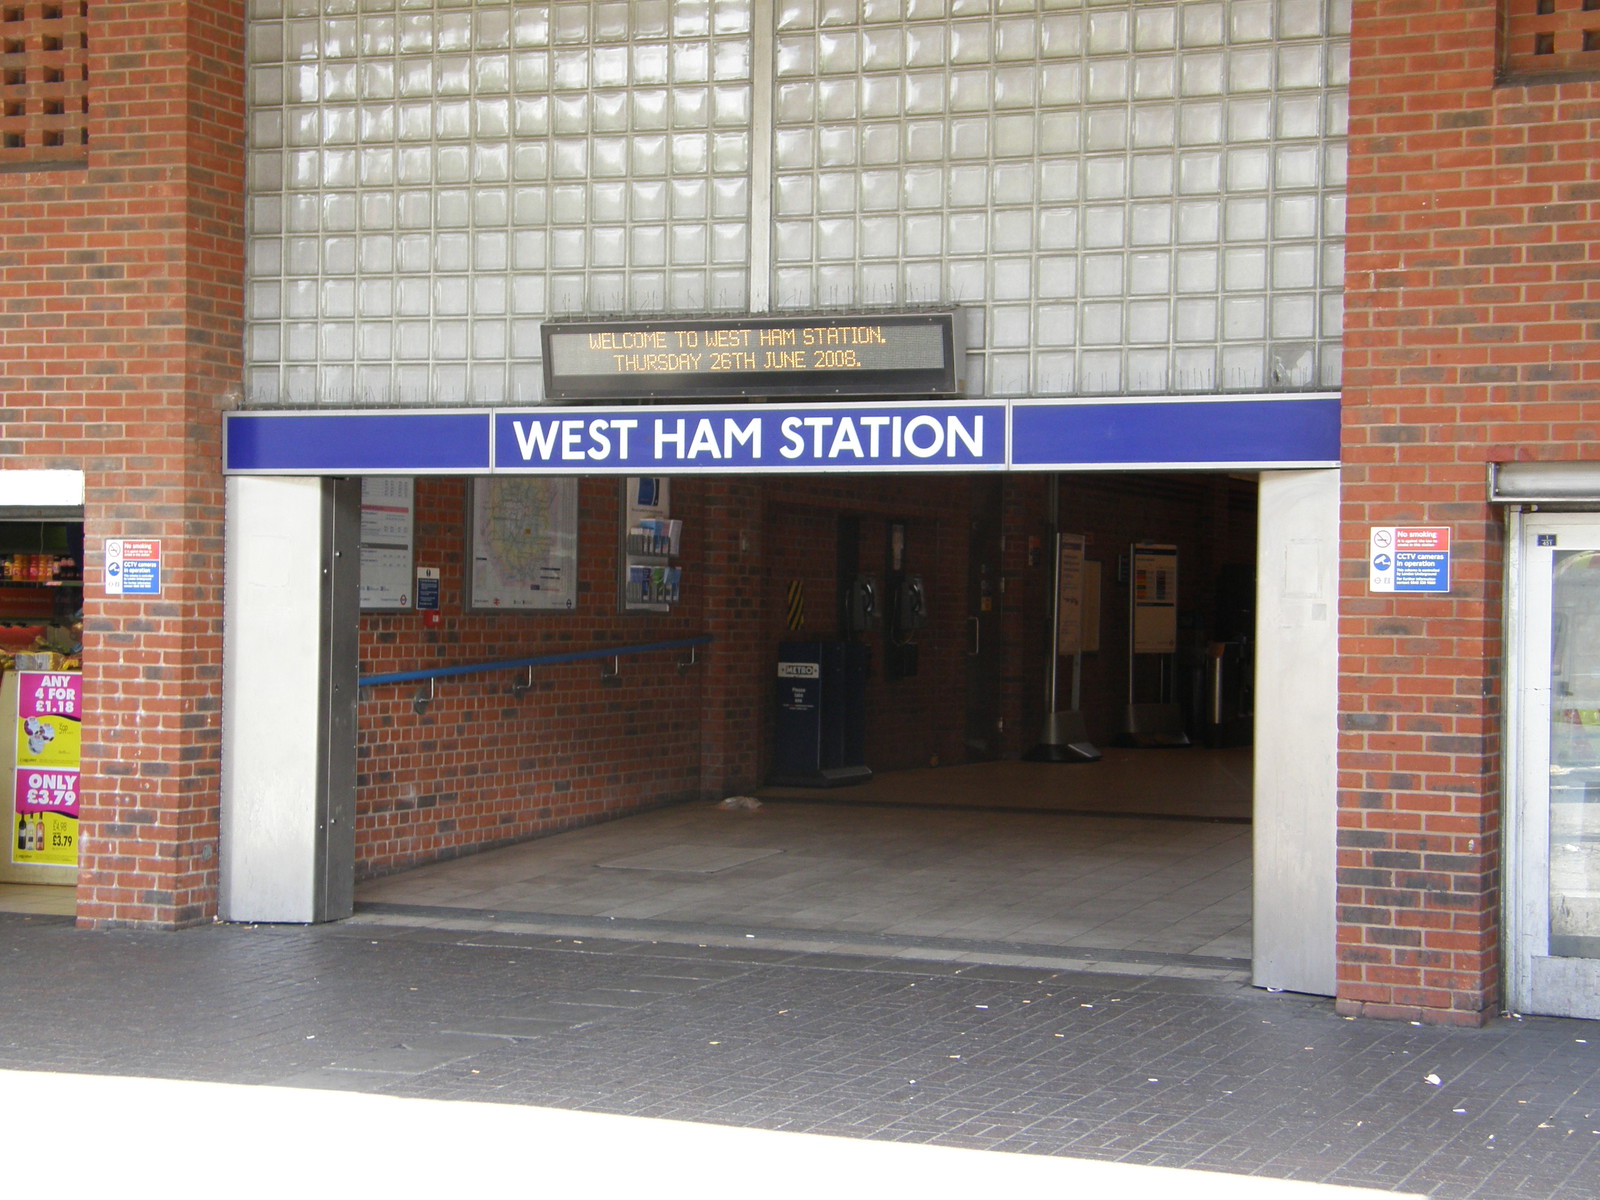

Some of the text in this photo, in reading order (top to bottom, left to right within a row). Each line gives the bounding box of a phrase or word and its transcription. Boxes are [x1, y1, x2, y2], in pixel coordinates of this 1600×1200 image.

[589, 326, 886, 350] WELCOME TO WEST HAM STATION.
[613, 350, 862, 371] THURSDAY 26TH JUNE 2008.
[512, 415, 984, 461] WEST HAM STATION
[786, 666, 812, 674] METRO
[41, 675, 71, 688] ANY
[35, 688, 76, 700] 4 FOR
[35, 700, 74, 713] £1.18
[28, 774, 77, 790] ONLY
[27, 789, 76, 806] £3.79
[52, 835, 72, 847] £3.79
